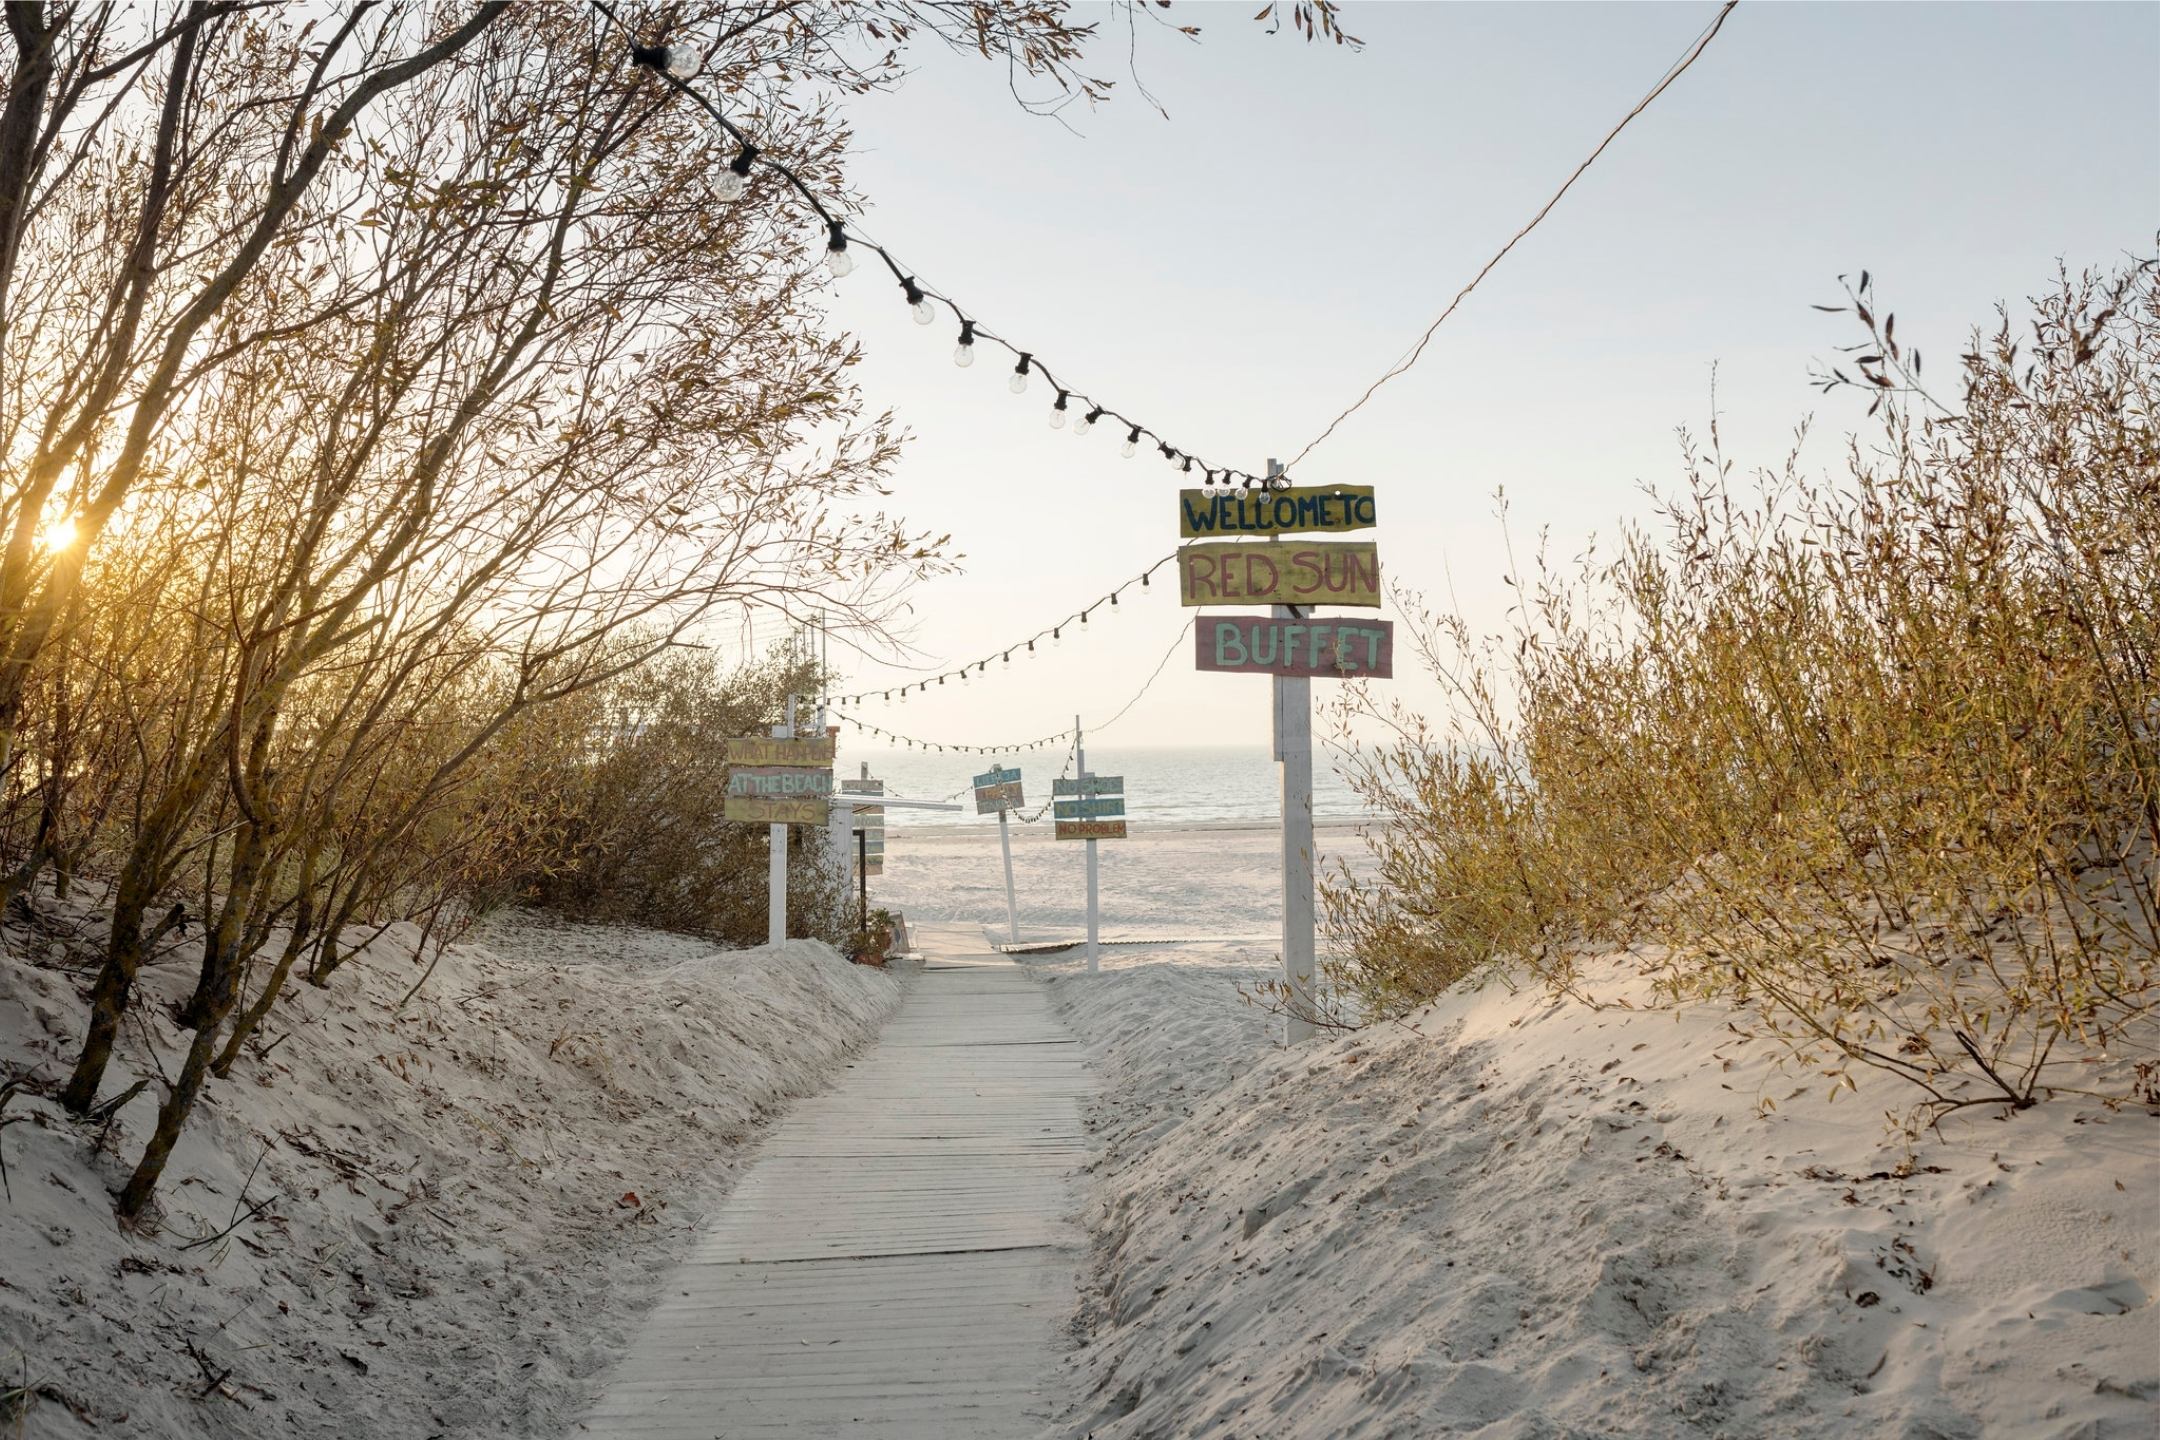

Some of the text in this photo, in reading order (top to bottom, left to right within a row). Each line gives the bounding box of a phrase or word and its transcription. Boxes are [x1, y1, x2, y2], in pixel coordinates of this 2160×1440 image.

[1188, 551, 1378, 600] RED SUN
[1215, 623, 1386, 671] BUFFET
[729, 742, 772, 761] WHAT
[782, 773, 832, 793] BEACH
[748, 802, 816, 821] STAYS
[1058, 822, 1125, 835] NO PROBLEM
